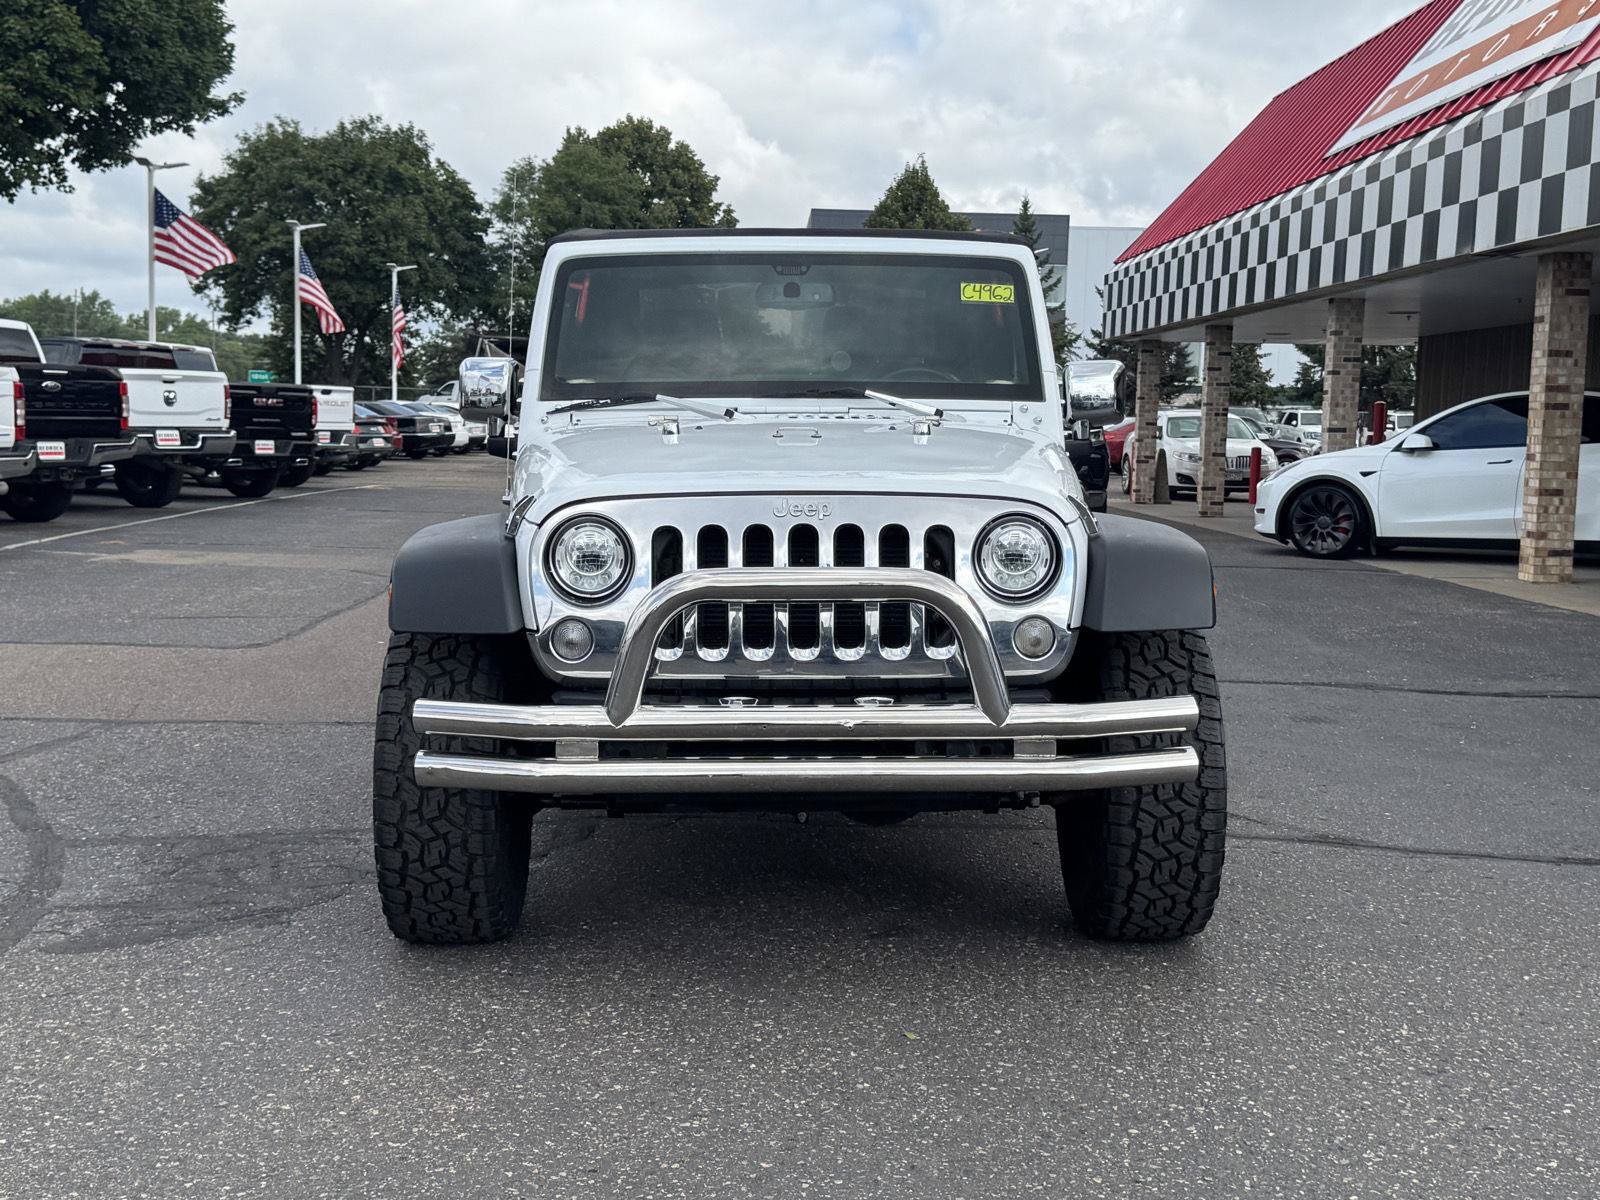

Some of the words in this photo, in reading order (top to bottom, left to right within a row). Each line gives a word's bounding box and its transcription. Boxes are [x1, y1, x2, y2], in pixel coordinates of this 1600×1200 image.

[962, 283, 1013, 301] C4962
[253, 398, 284, 407] GMC
[773, 498, 832, 520] Jeep
